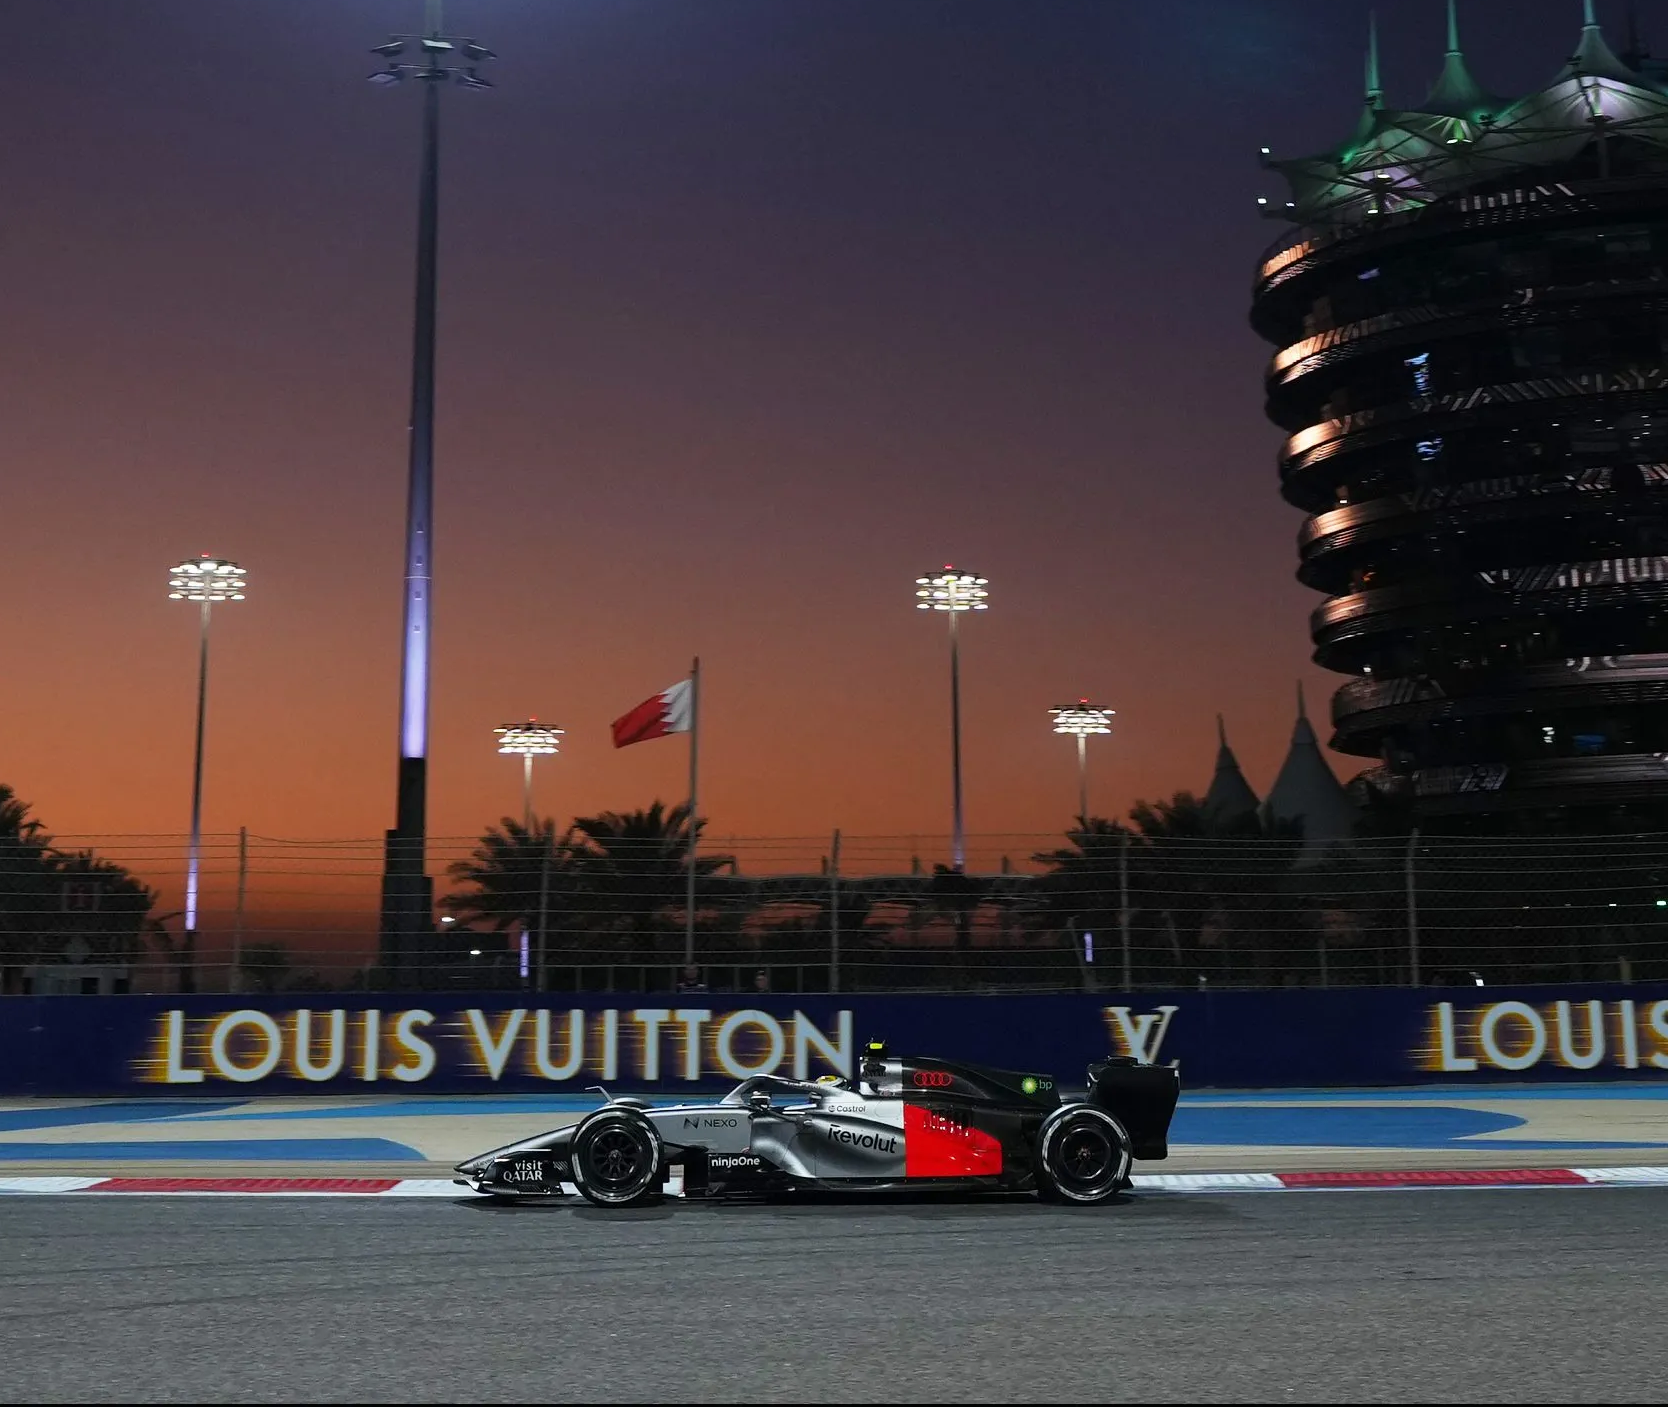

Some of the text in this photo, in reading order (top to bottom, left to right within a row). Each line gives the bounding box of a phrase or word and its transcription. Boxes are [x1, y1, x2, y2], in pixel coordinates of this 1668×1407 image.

[166, 1008, 853, 1083] LOUIS VUITTON
[1039, 1079, 1053, 1091] bp
[836, 1105, 866, 1113] Castrol
[704, 1119, 737, 1128] NEXO
[827, 1123, 897, 1153] Revolut
[515, 1160, 543, 1171] visit
[711, 1156, 761, 1169] ninjaOne
[503, 1170, 543, 1183] QATAR
